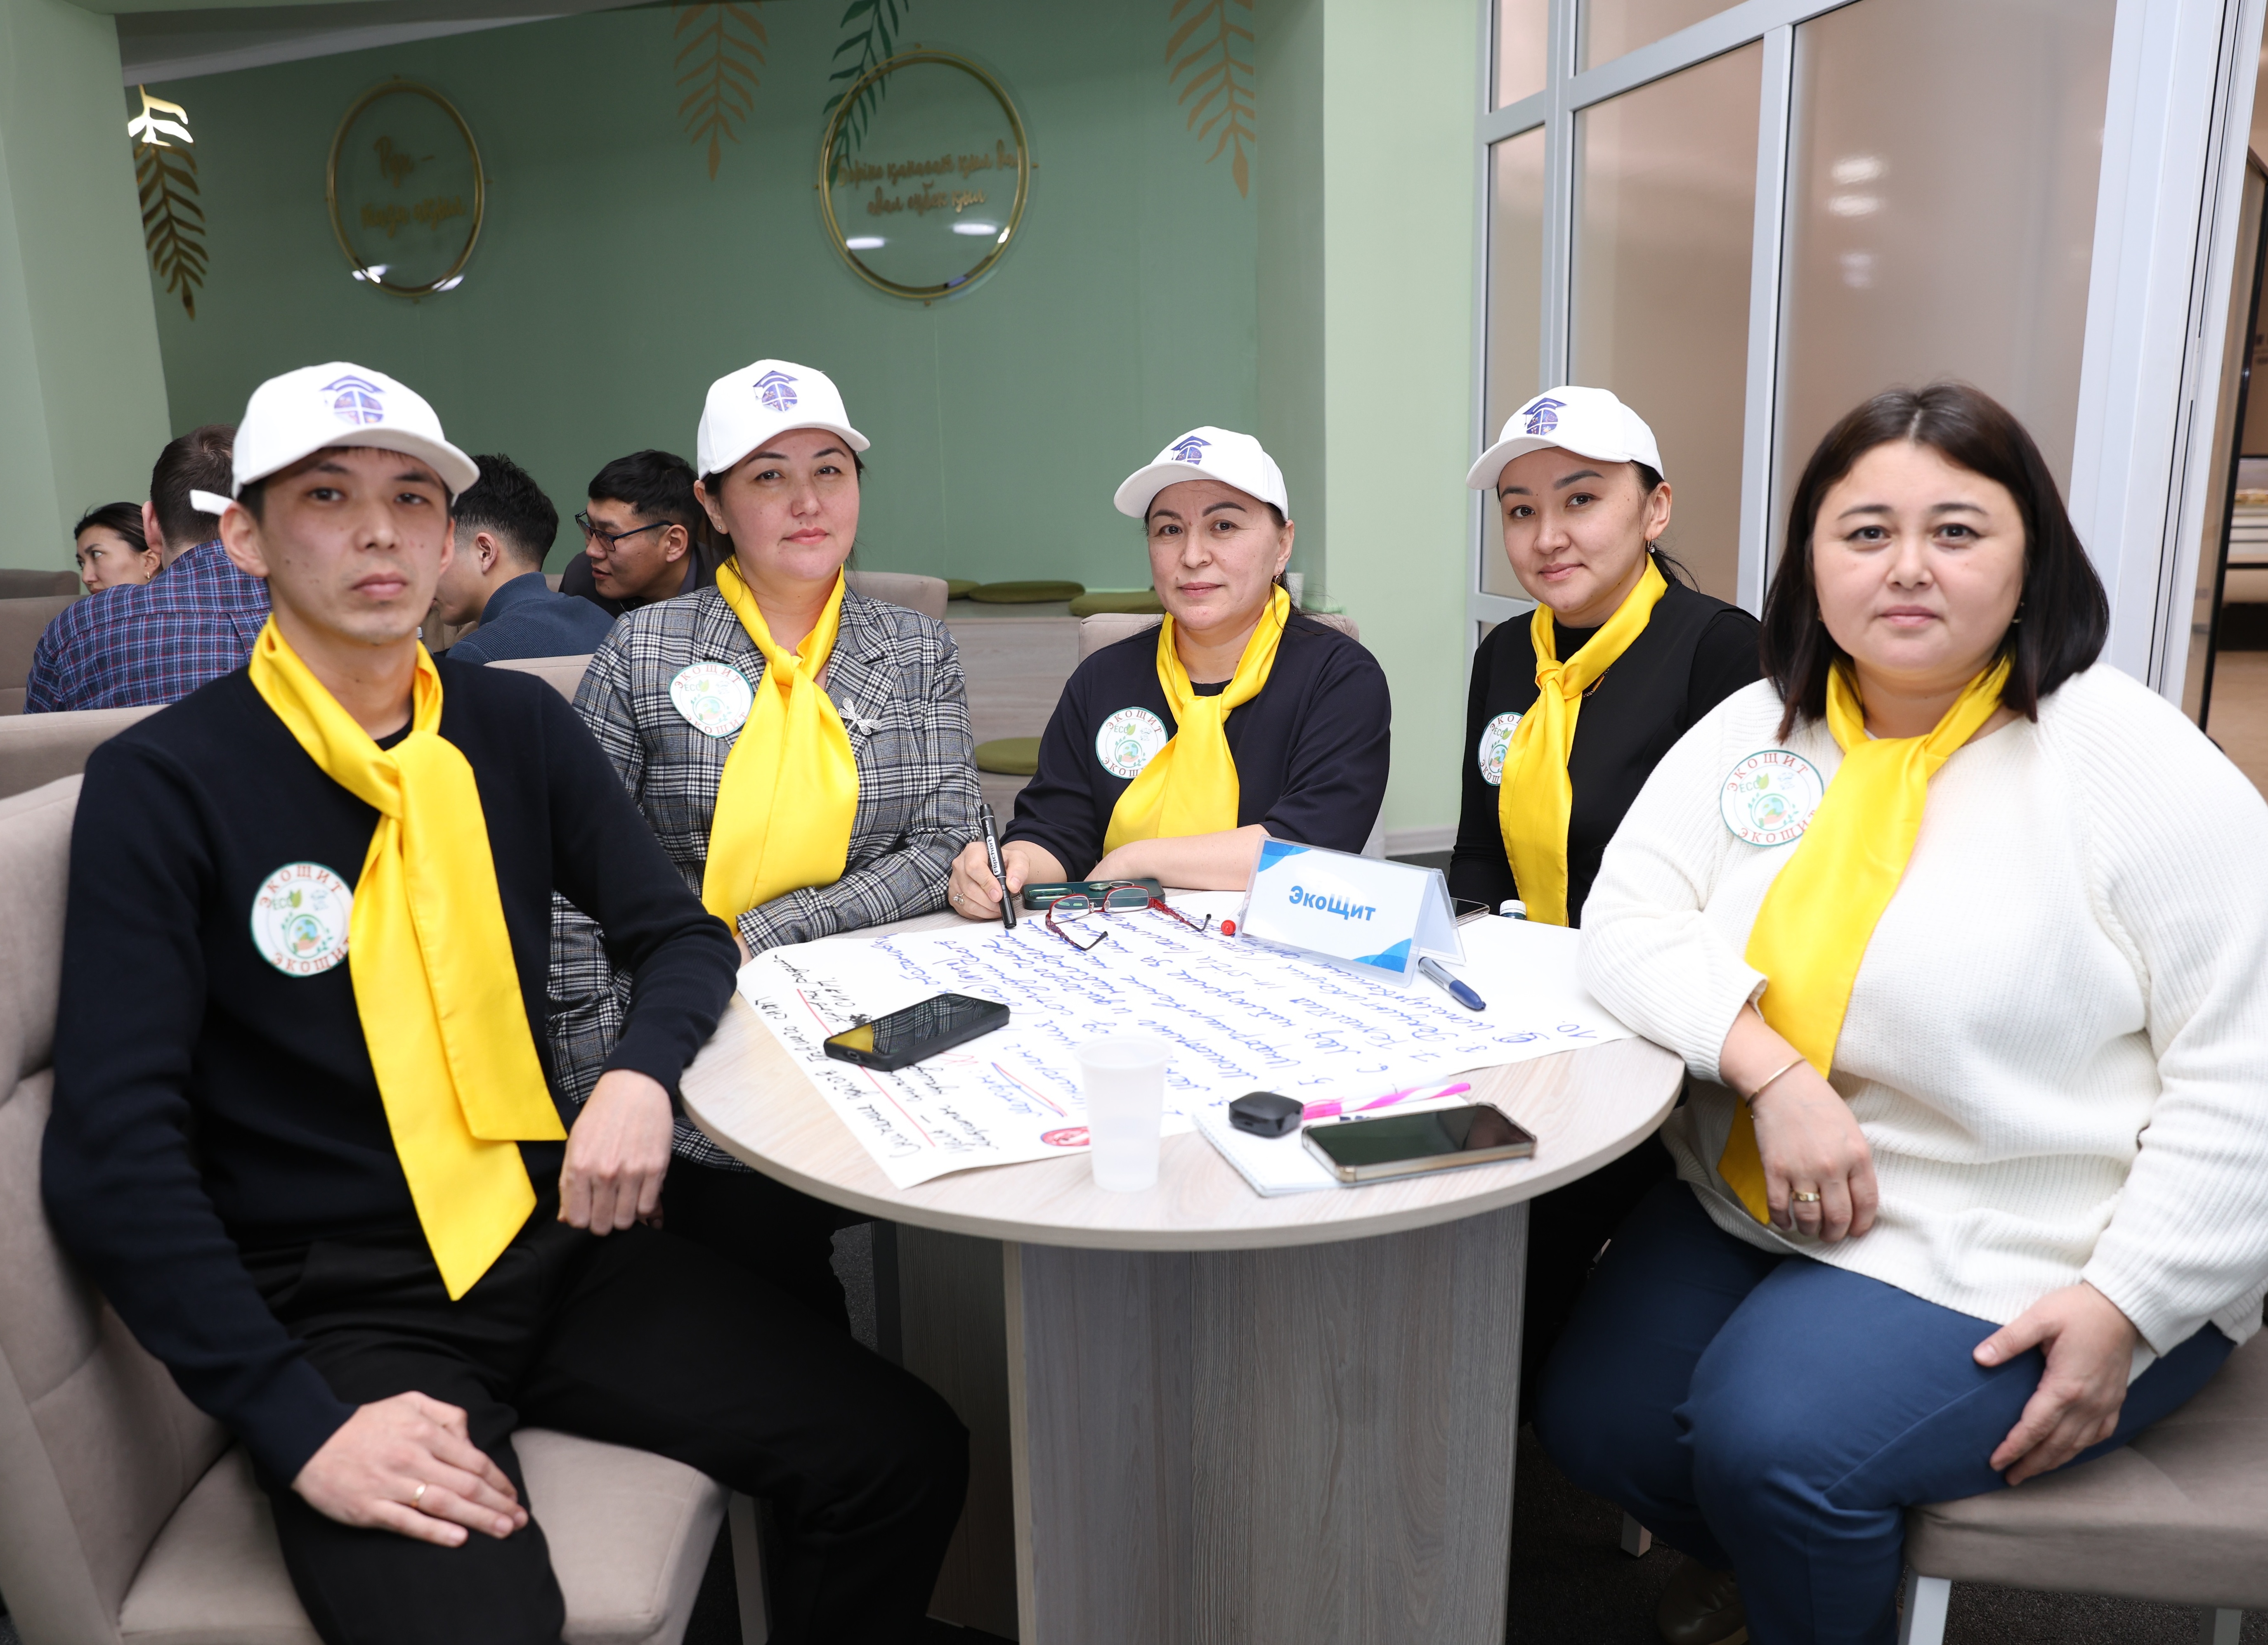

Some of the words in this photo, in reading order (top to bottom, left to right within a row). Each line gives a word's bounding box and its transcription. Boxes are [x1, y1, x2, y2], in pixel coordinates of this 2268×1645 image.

[675, 664, 741, 688] ЭКОЩИТ
[1106, 710, 1162, 733] ЭКОЩИТ
[1490, 715, 1523, 731] ЭКО
[1102, 757, 1139, 777] ЭКОЩ
[1480, 759, 1500, 784] ЭКОЩ
[1727, 753, 1809, 792] ЭКОЩИТ
[988, 838, 998, 873] Flipchart
[259, 864, 344, 908] ЭКОЩИТ
[1289, 885, 1376, 921] ЭкоЩит
